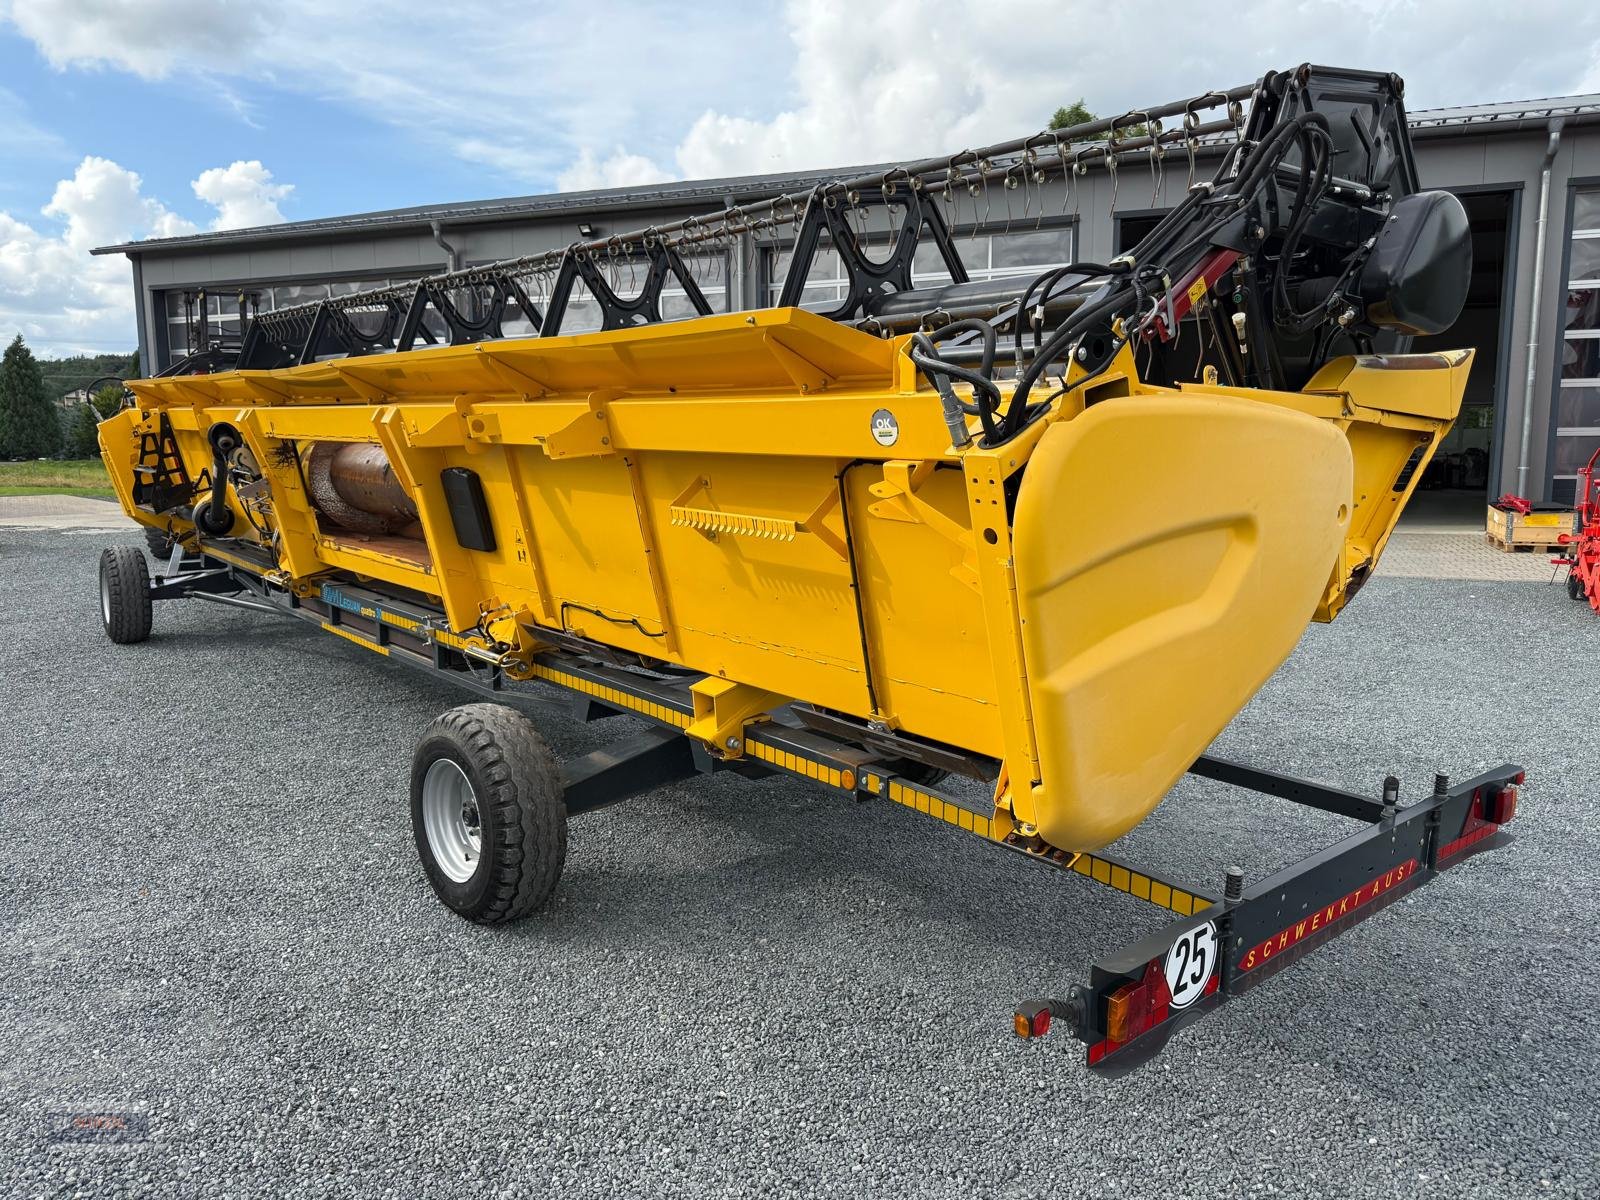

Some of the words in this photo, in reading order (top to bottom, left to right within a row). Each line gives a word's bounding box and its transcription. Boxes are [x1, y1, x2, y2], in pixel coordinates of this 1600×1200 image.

[876, 418, 892, 429] OK
[1247, 891, 1361, 968] SCHWENKT
[1372, 861, 1414, 896] AUS!
[1173, 927, 1208, 997] 25
